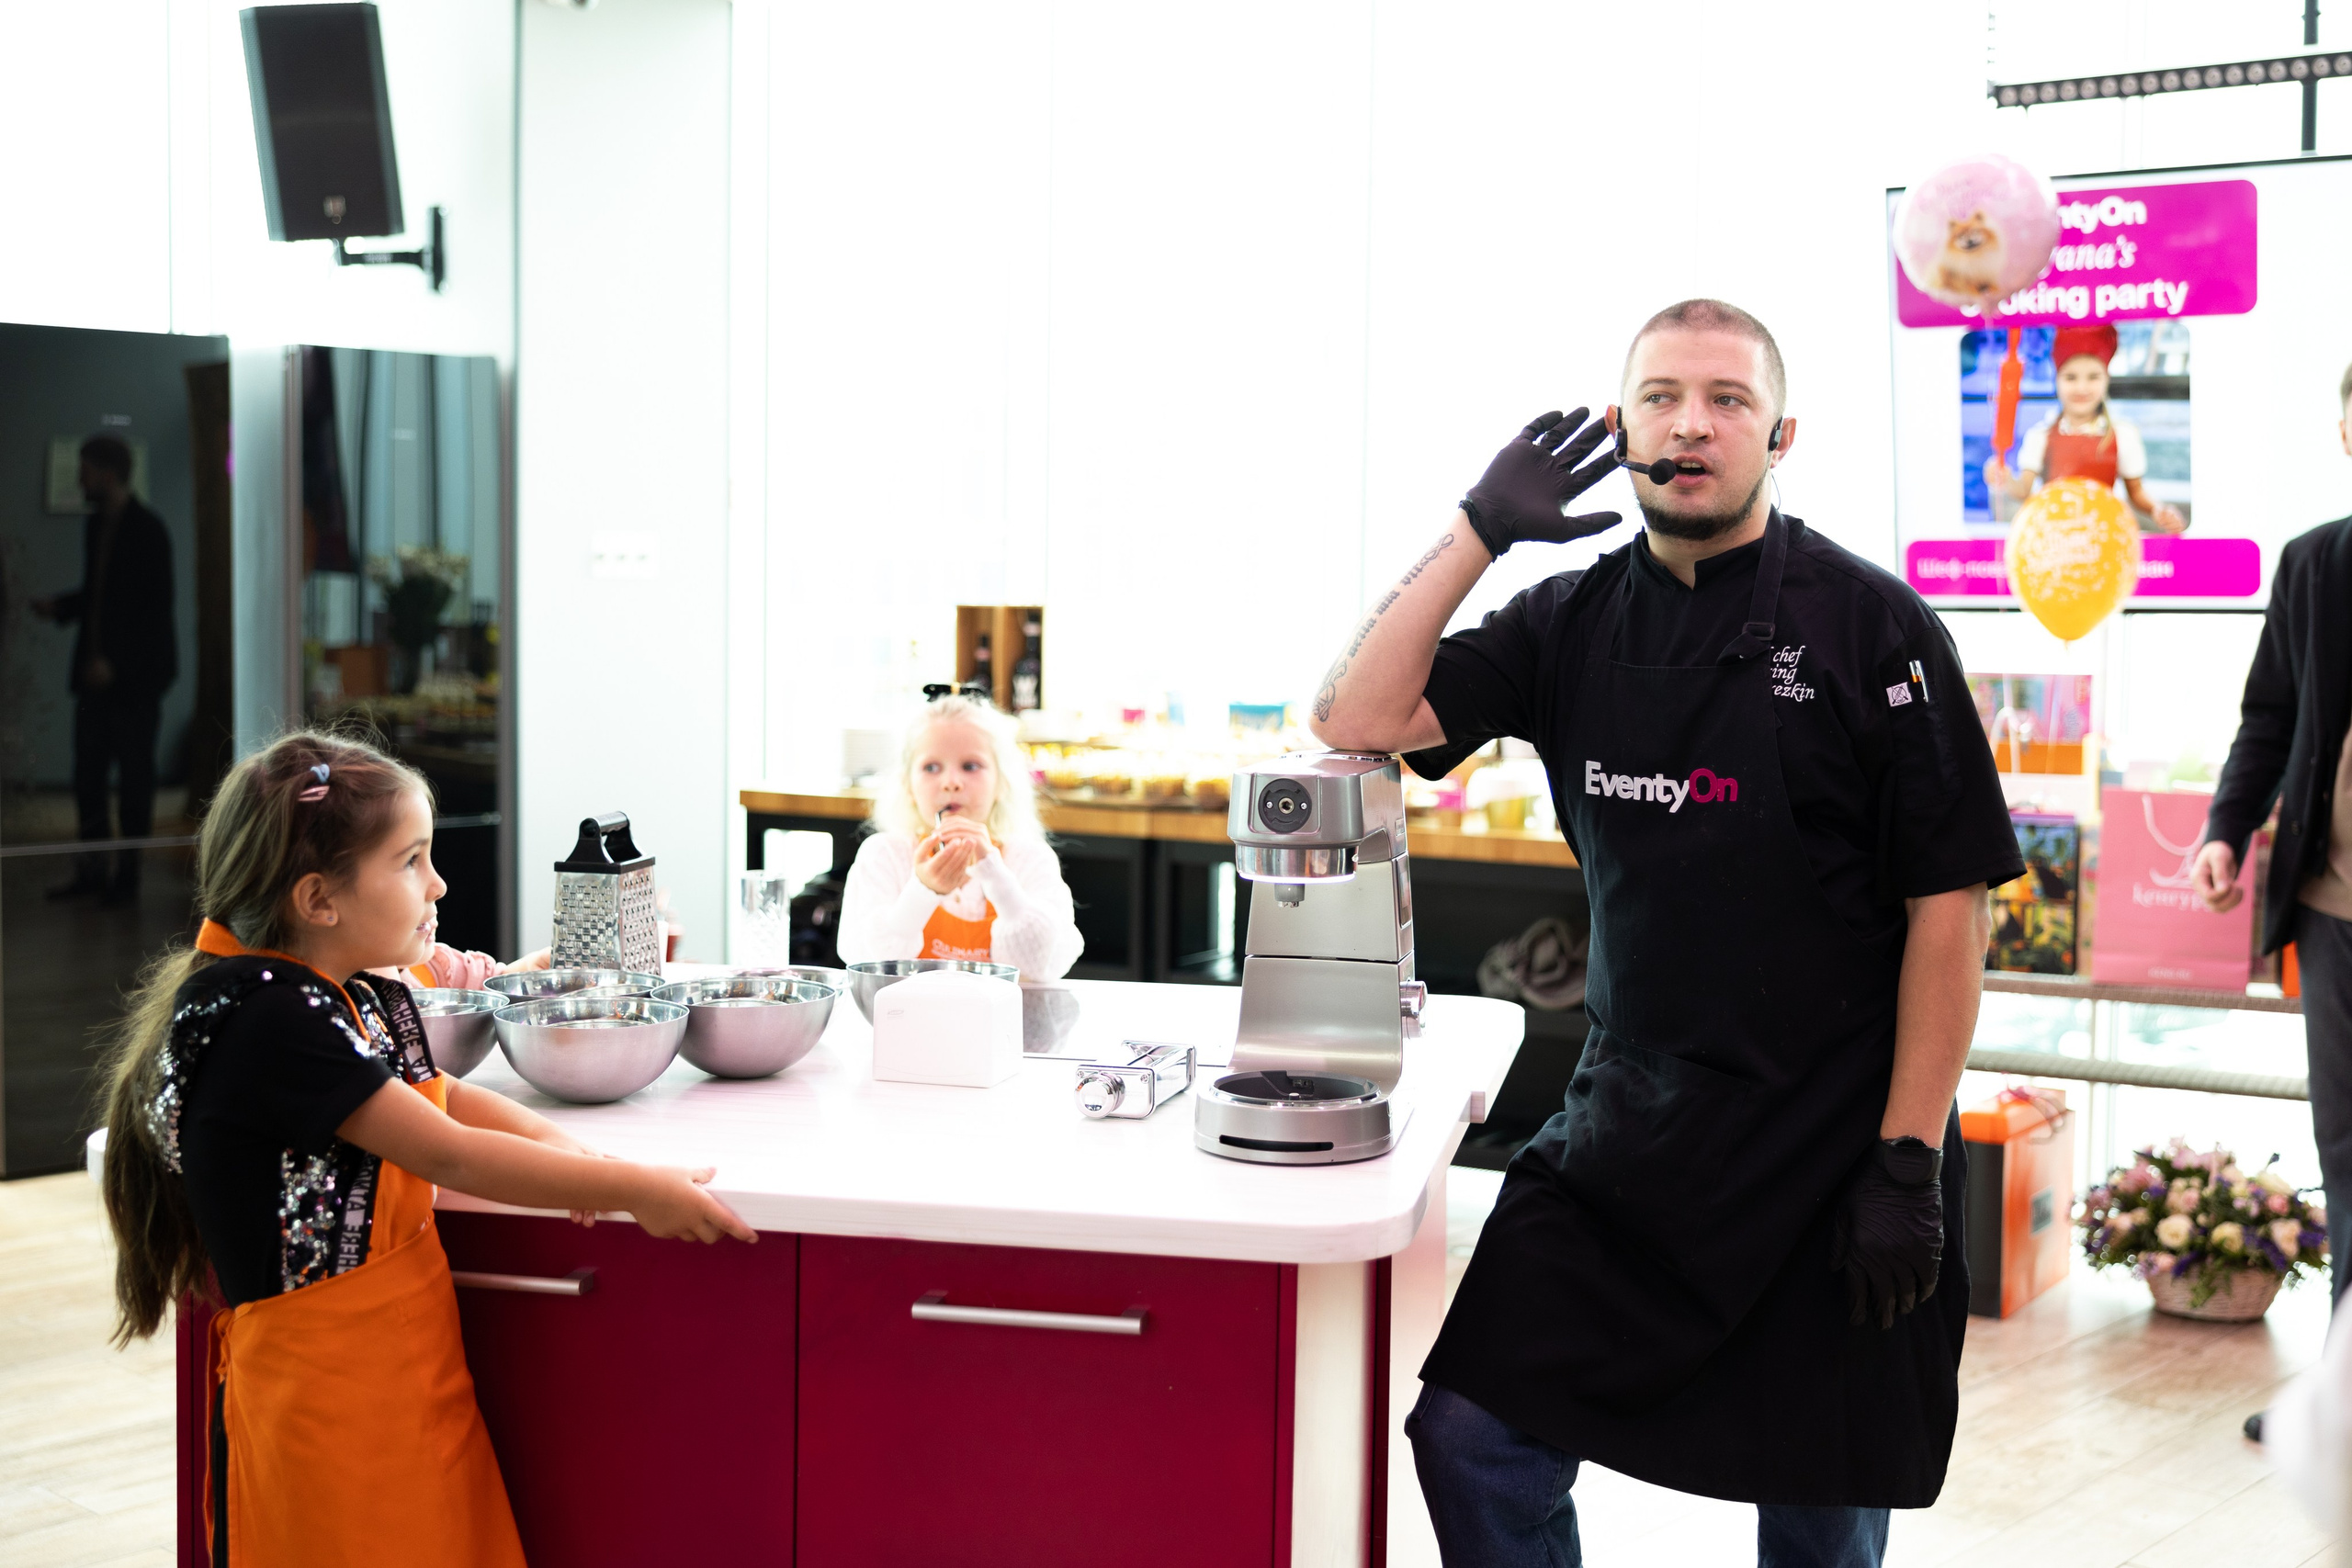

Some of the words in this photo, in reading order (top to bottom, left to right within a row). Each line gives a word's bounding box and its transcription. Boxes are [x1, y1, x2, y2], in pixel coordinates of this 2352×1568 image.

[2095, 278, 2189, 319] party
[1772, 646, 1806, 668] chef
[1770, 663, 1798, 685] ing
[1771, 682, 1815, 703] ezkin
[1584, 760, 1738, 813] EventyOn
